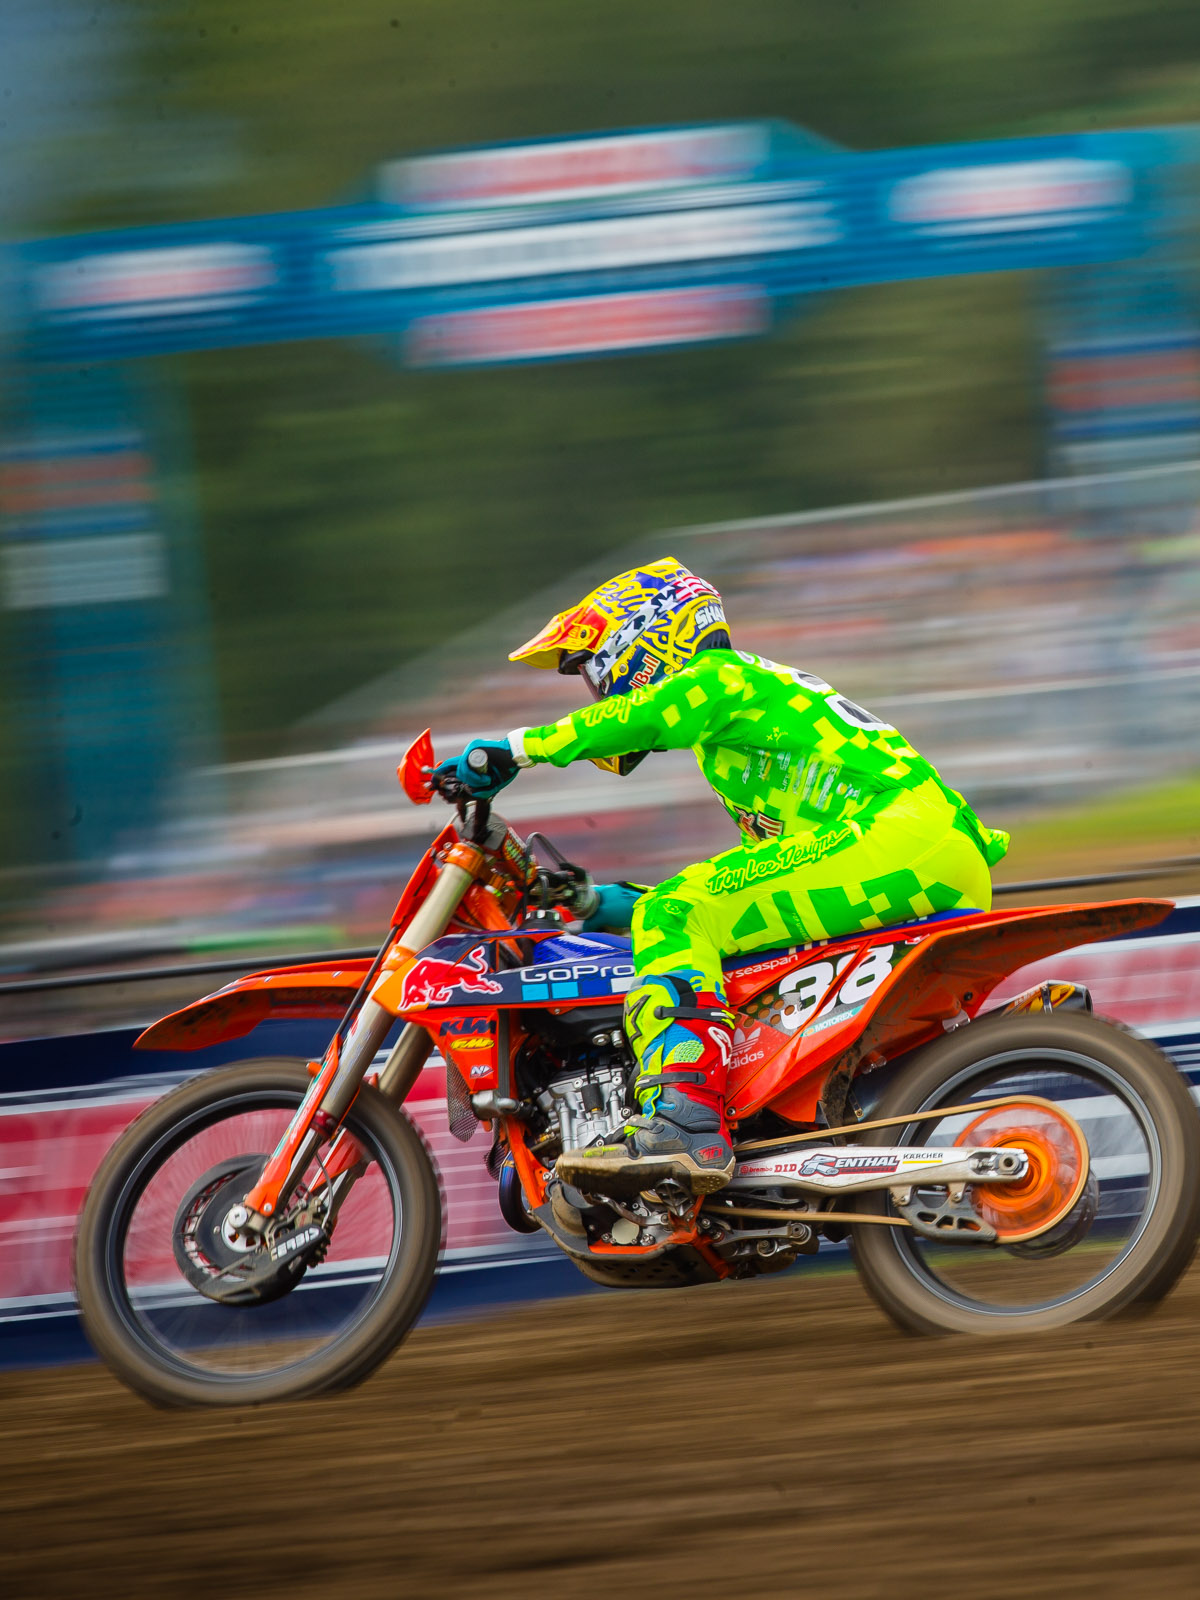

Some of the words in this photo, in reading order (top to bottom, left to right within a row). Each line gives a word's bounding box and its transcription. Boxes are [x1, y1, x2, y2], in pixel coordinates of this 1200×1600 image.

[705, 866, 745, 895] Troy
[745, 859, 780, 881] Lee
[777, 829, 846, 869] Designs
[520, 964, 636, 983] GoPro
[736, 953, 798, 978] seaspan
[778, 944, 895, 1030] 38
[439, 1016, 497, 1037] KTM
[814, 1009, 854, 1032] MOTOREX
[729, 1050, 765, 1070] didas
[749, 1165, 773, 1173] brembo
[774, 1163, 797, 1173] DID
